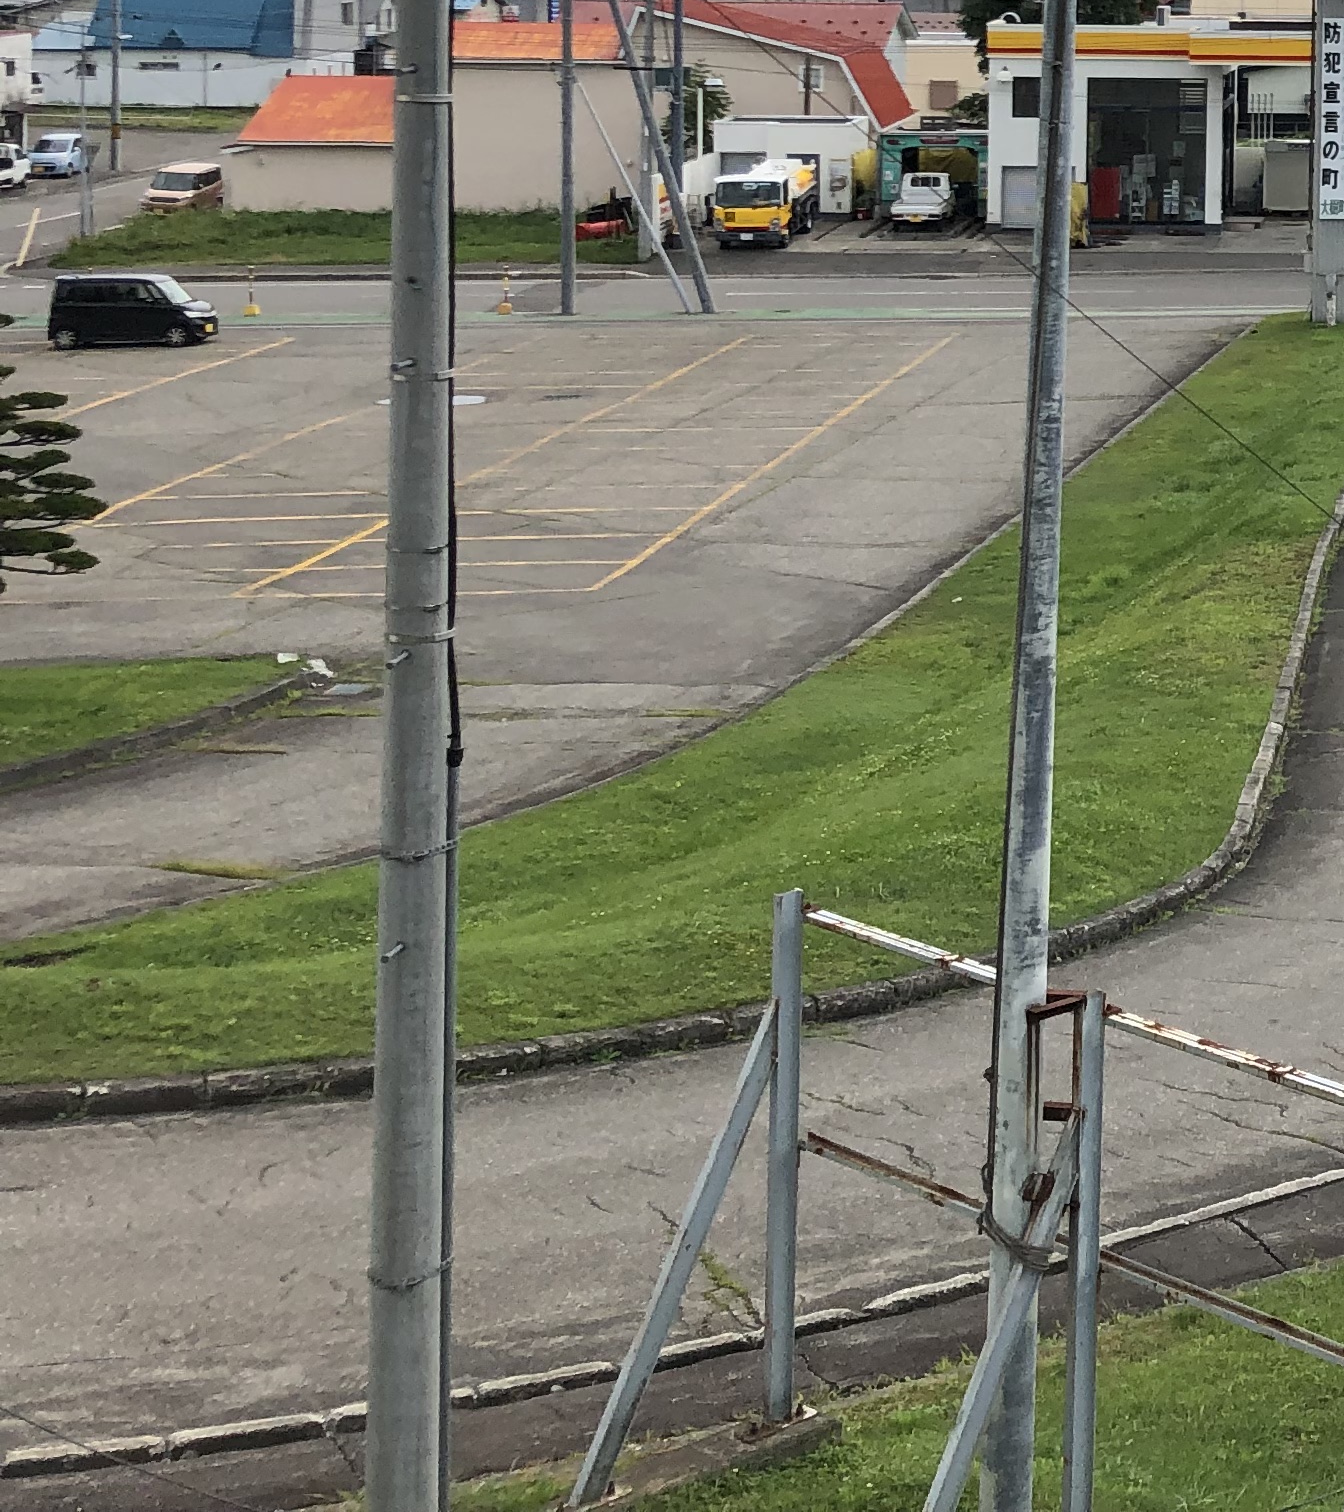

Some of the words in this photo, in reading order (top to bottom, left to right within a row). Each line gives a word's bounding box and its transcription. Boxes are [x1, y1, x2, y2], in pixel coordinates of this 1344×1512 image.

[1322, 22, 1341, 190] 防犯宣言の町
